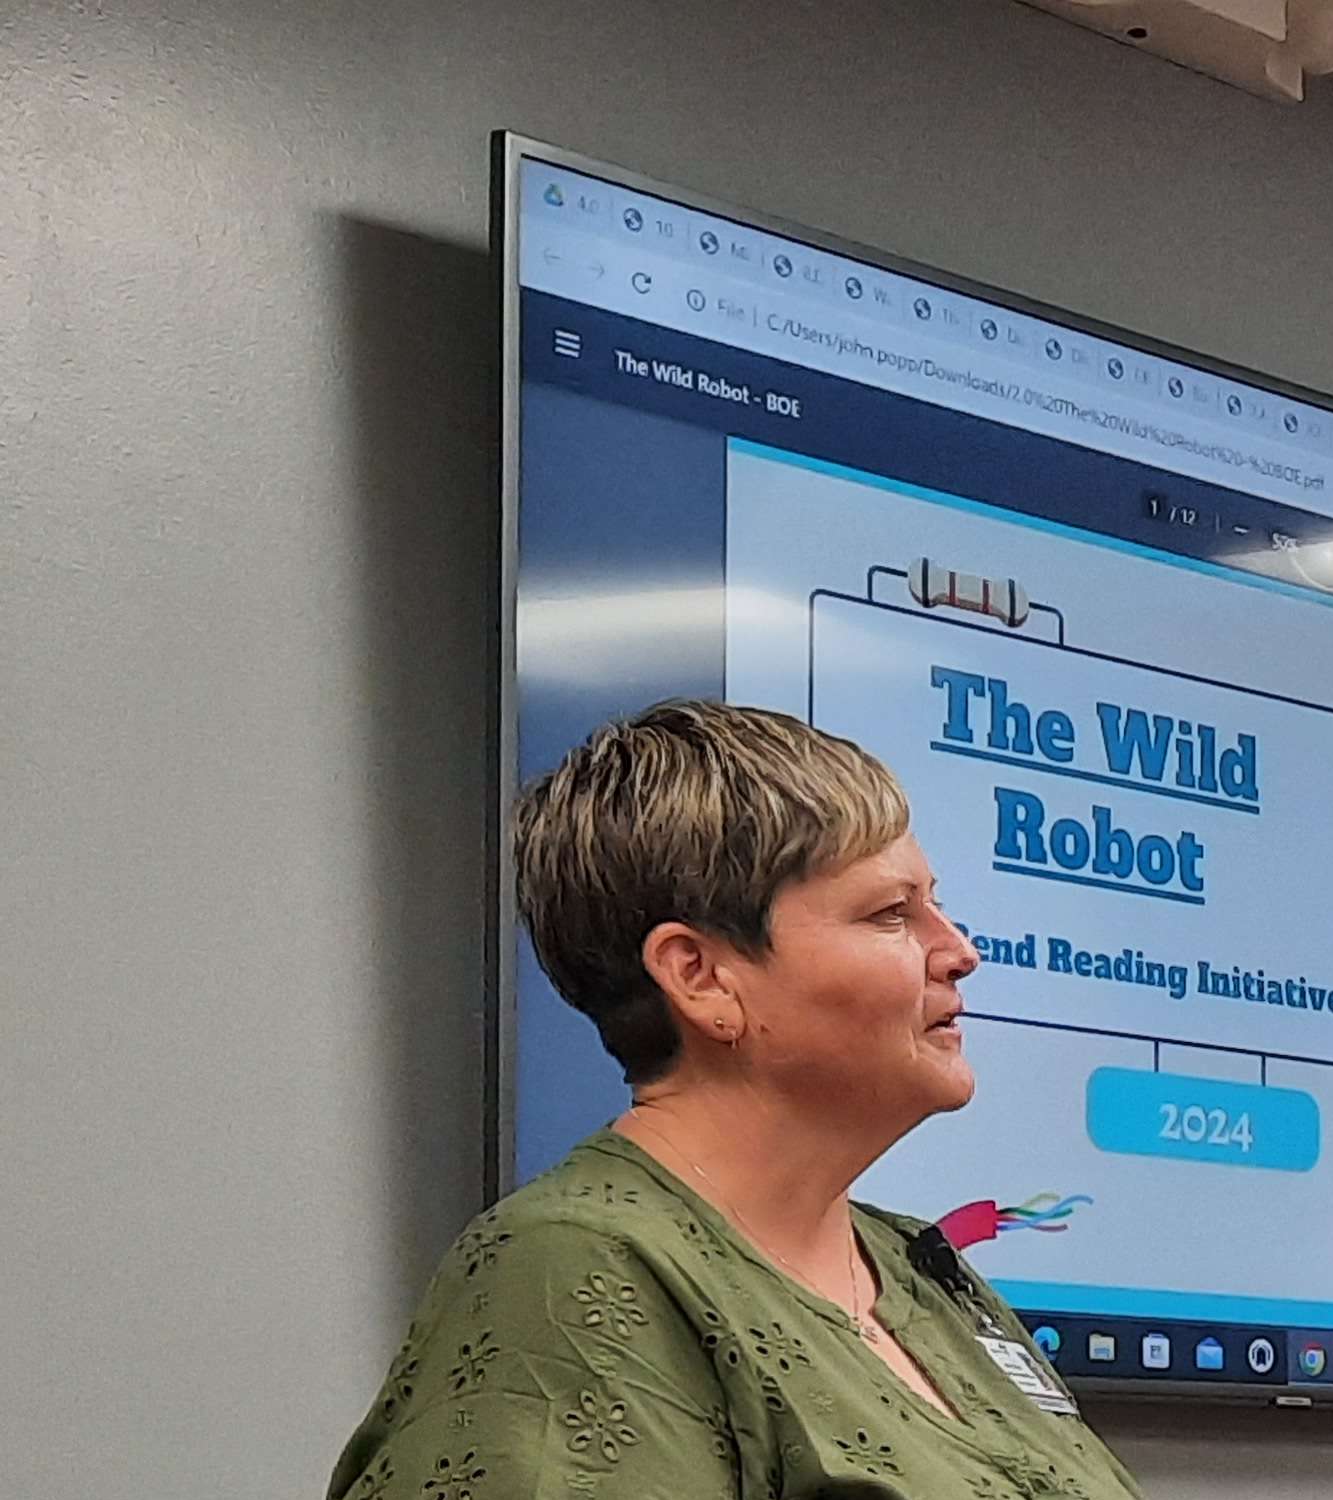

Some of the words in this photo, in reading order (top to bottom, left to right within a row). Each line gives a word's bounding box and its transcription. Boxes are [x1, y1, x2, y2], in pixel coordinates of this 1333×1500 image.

[615, 350, 648, 376] The
[652, 361, 693, 389] Wild
[698, 374, 749, 404] Robot
[766, 393, 801, 418] BOE
[930, 665, 1075, 763] The
[1096, 701, 1260, 800] Wild
[993, 786, 1205, 892] Robot
[954, 922, 1037, 970] end
[1047, 936, 1188, 1000] Reading
[1157, 1103, 1253, 1153] 2024
